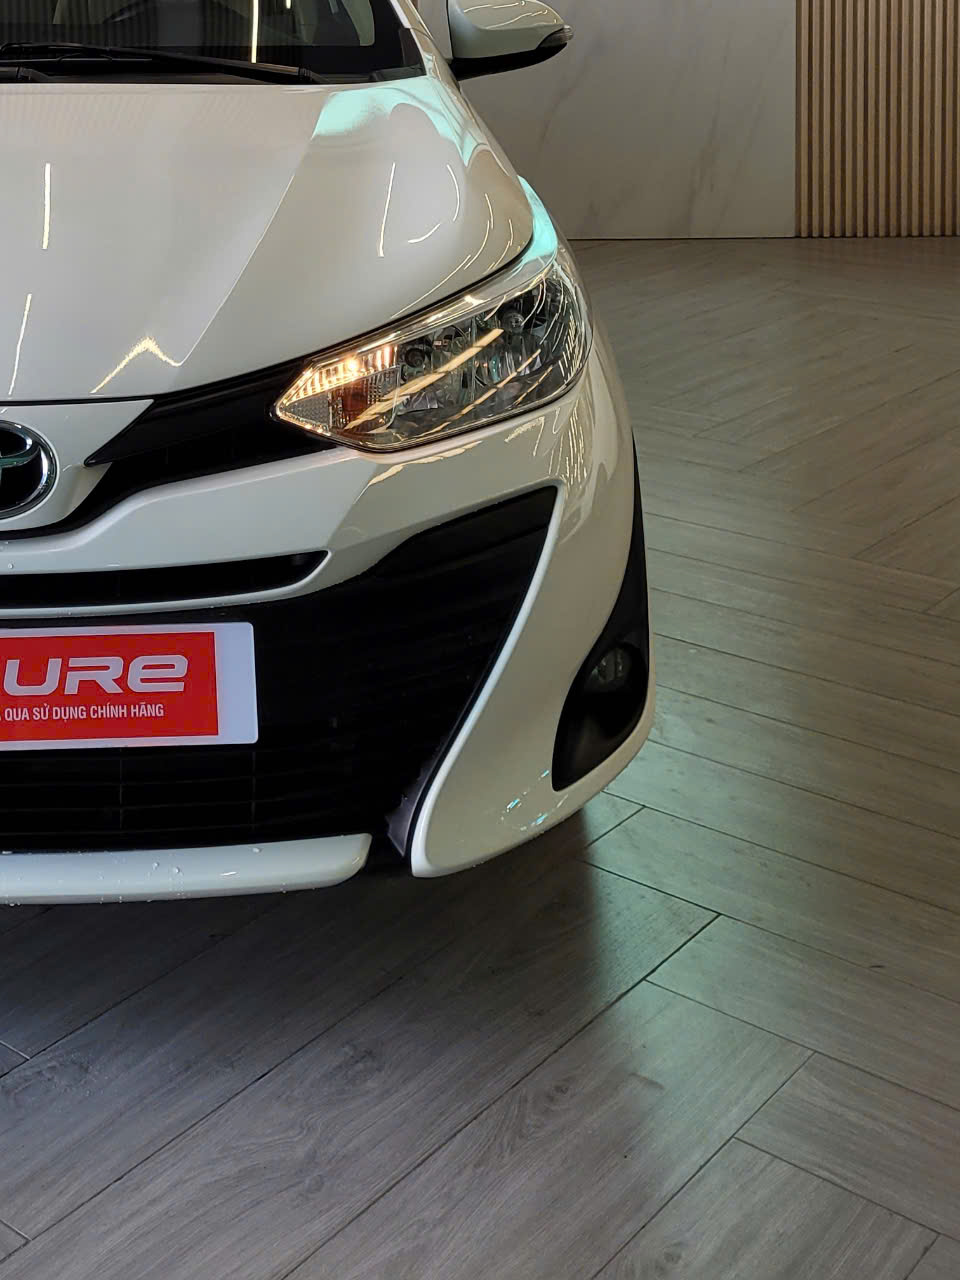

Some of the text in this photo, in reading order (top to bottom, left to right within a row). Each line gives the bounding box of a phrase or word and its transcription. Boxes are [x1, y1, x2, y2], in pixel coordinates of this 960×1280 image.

[4, 708, 30, 723] QUA
[32, 703, 50, 721] SỬ
[52, 706, 87, 723] DỤNG
[90, 701, 127, 719] CHÍNH
[130, 700, 164, 717] HÃNG
